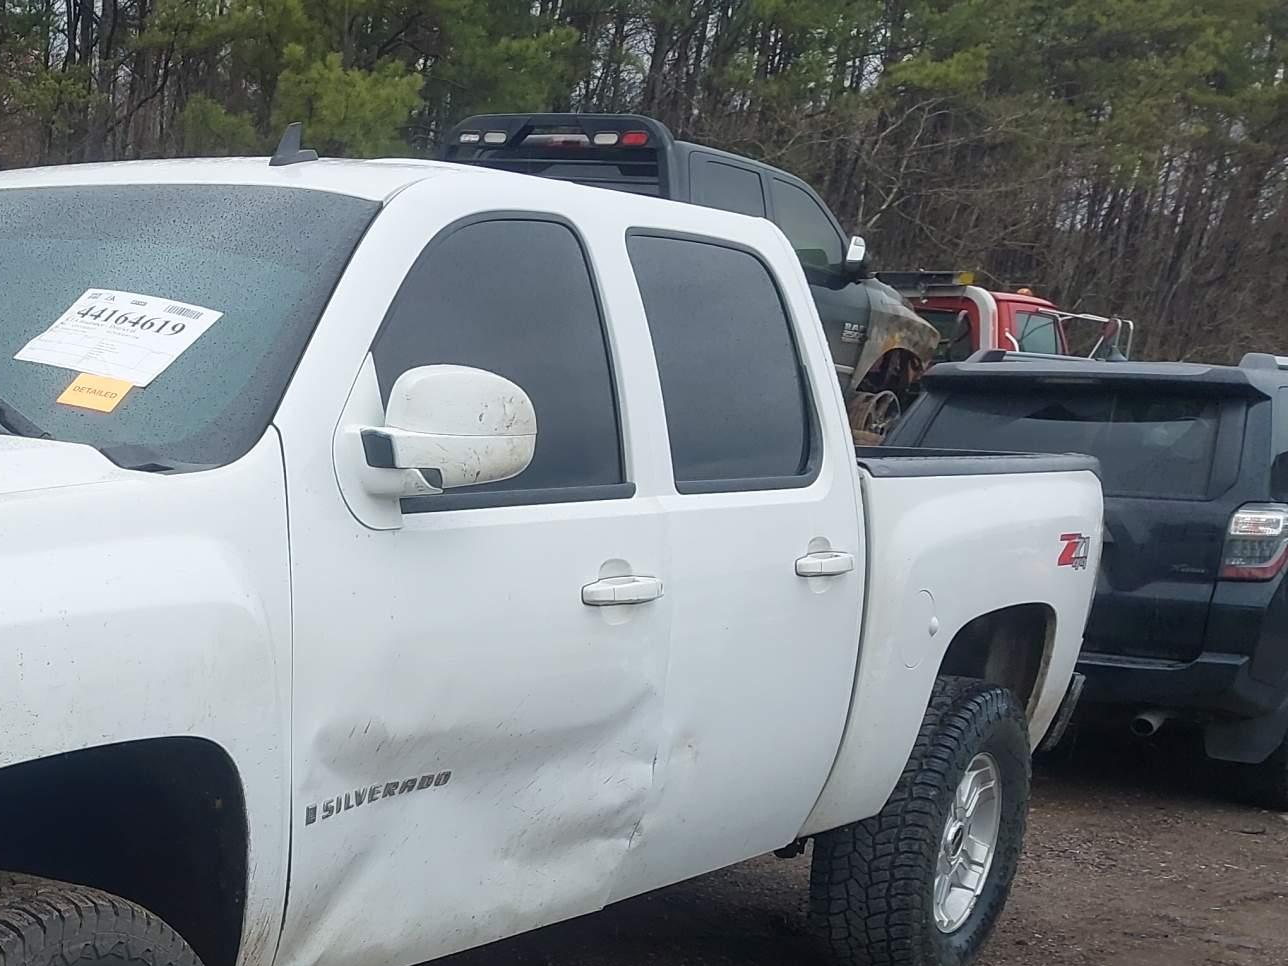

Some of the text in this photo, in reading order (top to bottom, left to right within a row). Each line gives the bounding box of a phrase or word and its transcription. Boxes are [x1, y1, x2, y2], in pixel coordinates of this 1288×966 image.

[76, 304, 186, 336] 44164619
[72, 385, 119, 400] DETAILED
[321, 770, 453, 820] SILVERADO
